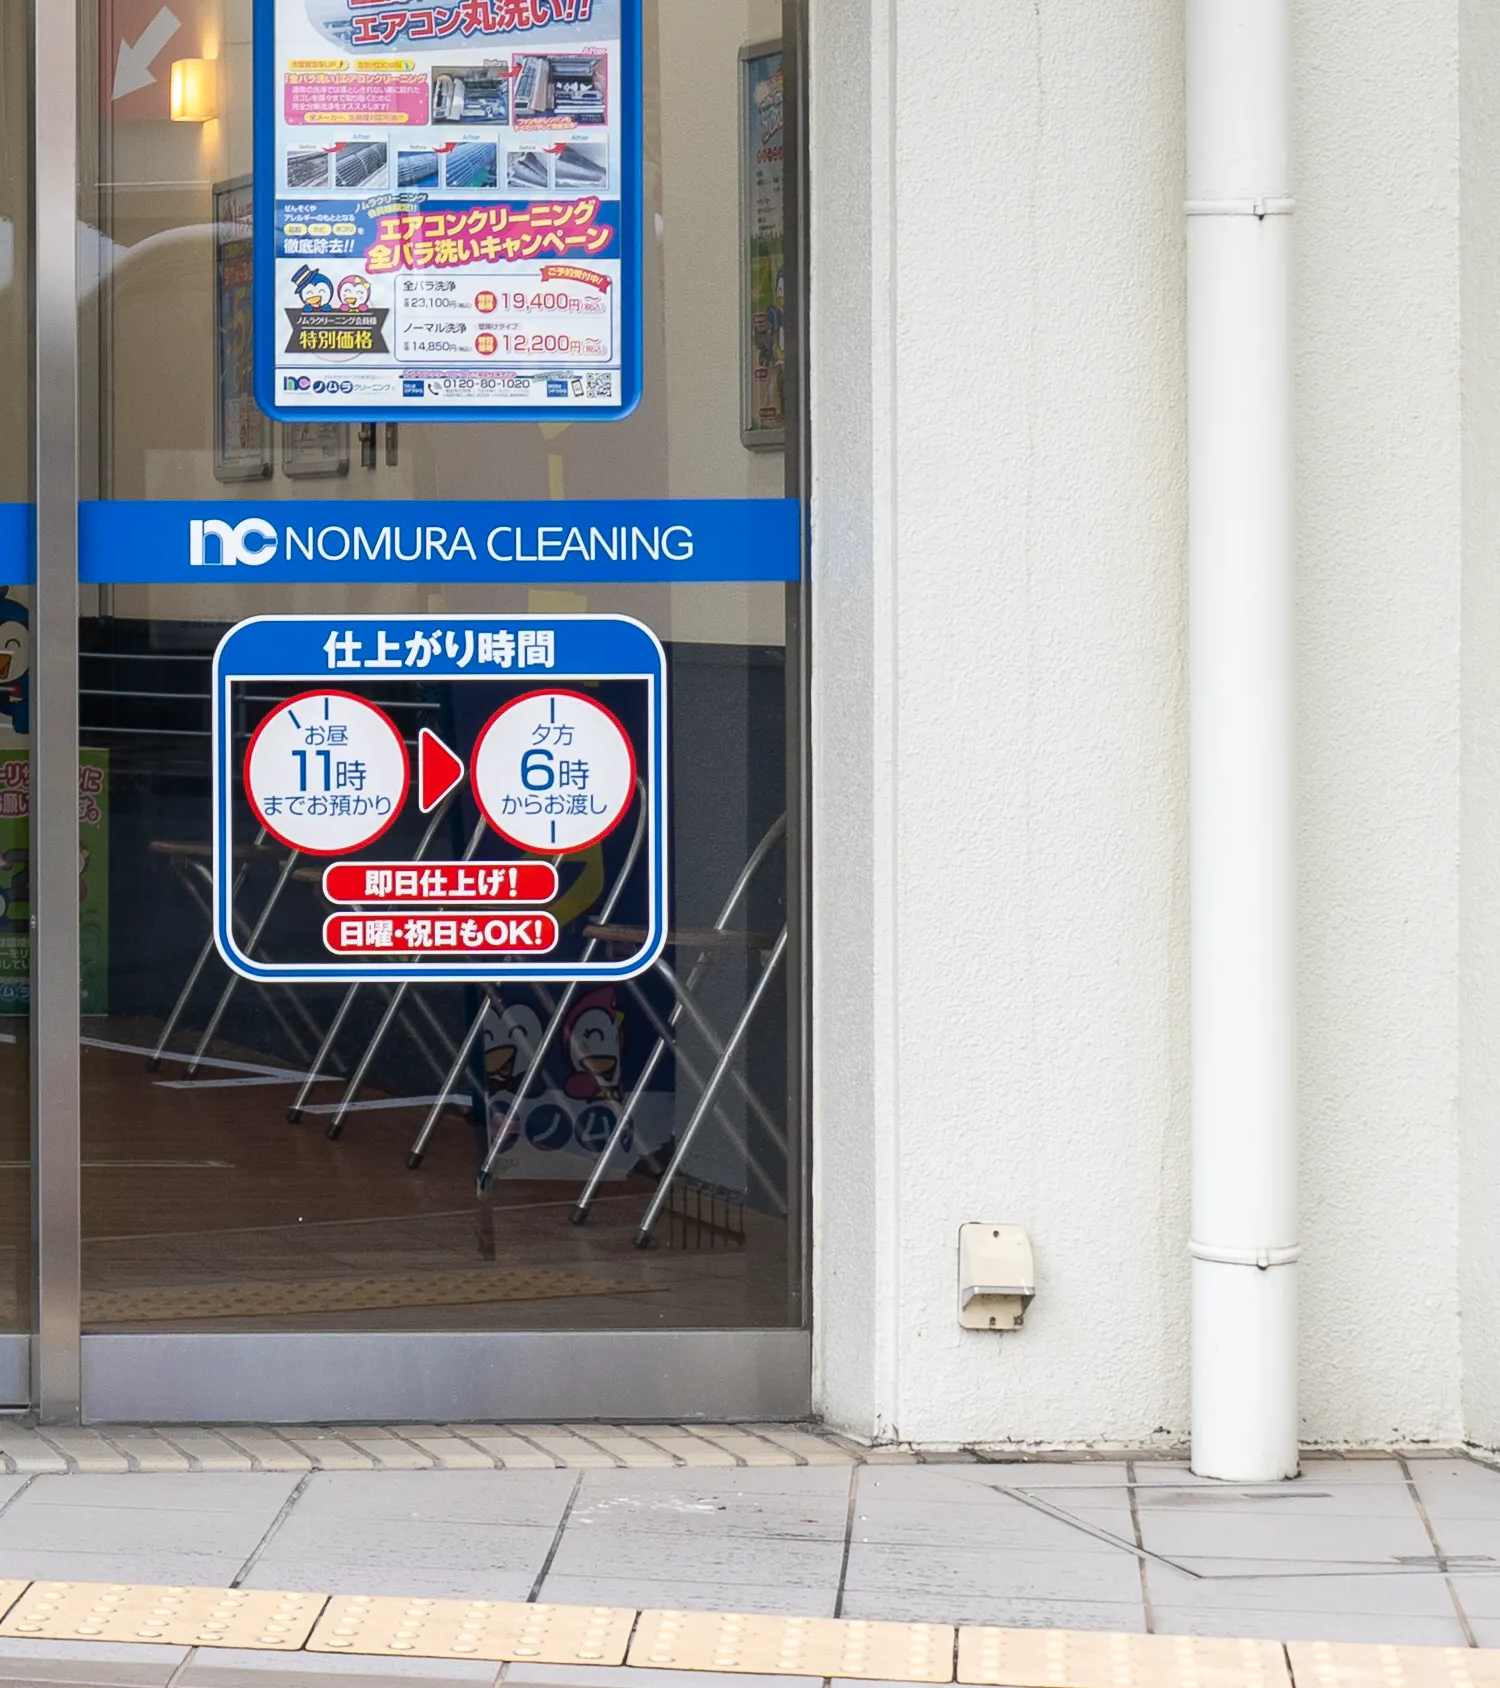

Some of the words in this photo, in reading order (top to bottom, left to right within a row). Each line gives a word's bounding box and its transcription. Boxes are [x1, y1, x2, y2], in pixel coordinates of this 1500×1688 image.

[380, 199, 597, 242] エアコンクリーニング
[284, 238, 356, 255] 徹底除去!!
[368, 227, 610, 271] 全バラ洗いキャンペーン
[403, 280, 457, 293] 全バラ洗浄
[299, 330, 373, 350] 特別価格
[403, 322, 467, 334] ノーマル洗浄
[443, 379, 531, 389] 0120-80-1020
[189, 518, 279, 566] nc
[286, 525, 477, 561] NOMURA
[487, 524, 695, 562] CLEANING
[323, 630, 556, 668] 仕上がり時間
[304, 724, 349, 746] お昼
[531, 723, 576, 747] 夕方
[290, 749, 368, 792] 11時
[520, 748, 590, 792] 6時
[263, 794, 392, 818] までお預かり
[501, 794, 608, 817] からお渡し
[364, 868, 519, 898] 即日仕上げ!
[338, 918, 543, 948] 日曜・祝日もOK!
